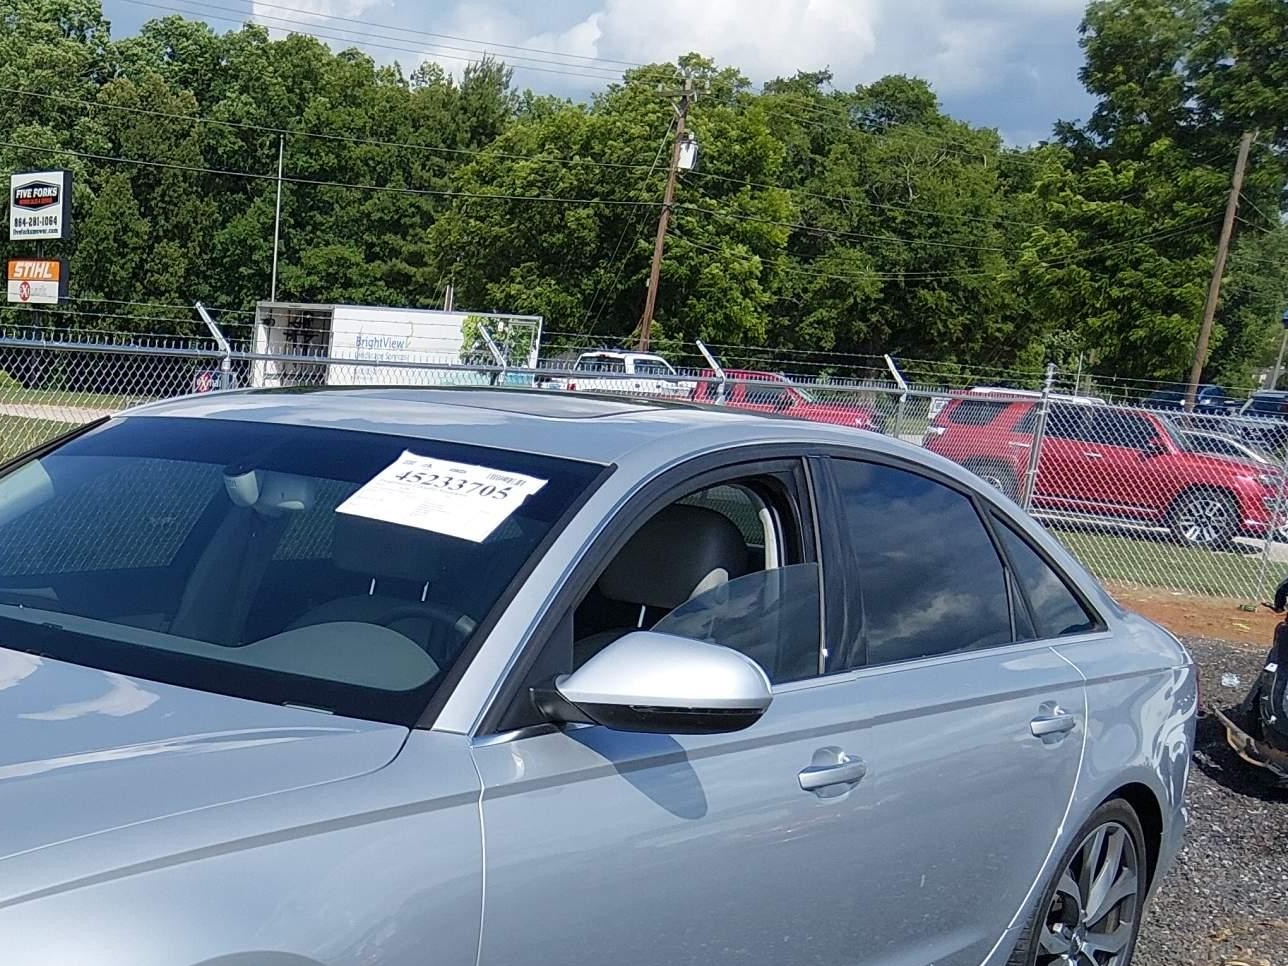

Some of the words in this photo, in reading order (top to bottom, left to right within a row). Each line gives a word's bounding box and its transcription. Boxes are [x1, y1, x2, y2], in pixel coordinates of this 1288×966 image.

[16, 189, 32, 199] FIVE
[33, 187, 58, 198] FORKS
[14, 216, 58, 227] 864-281-1064
[13, 261, 53, 278] STIHL
[355, 335, 405, 349] BrightView
[395, 471, 513, 500] 45233705
